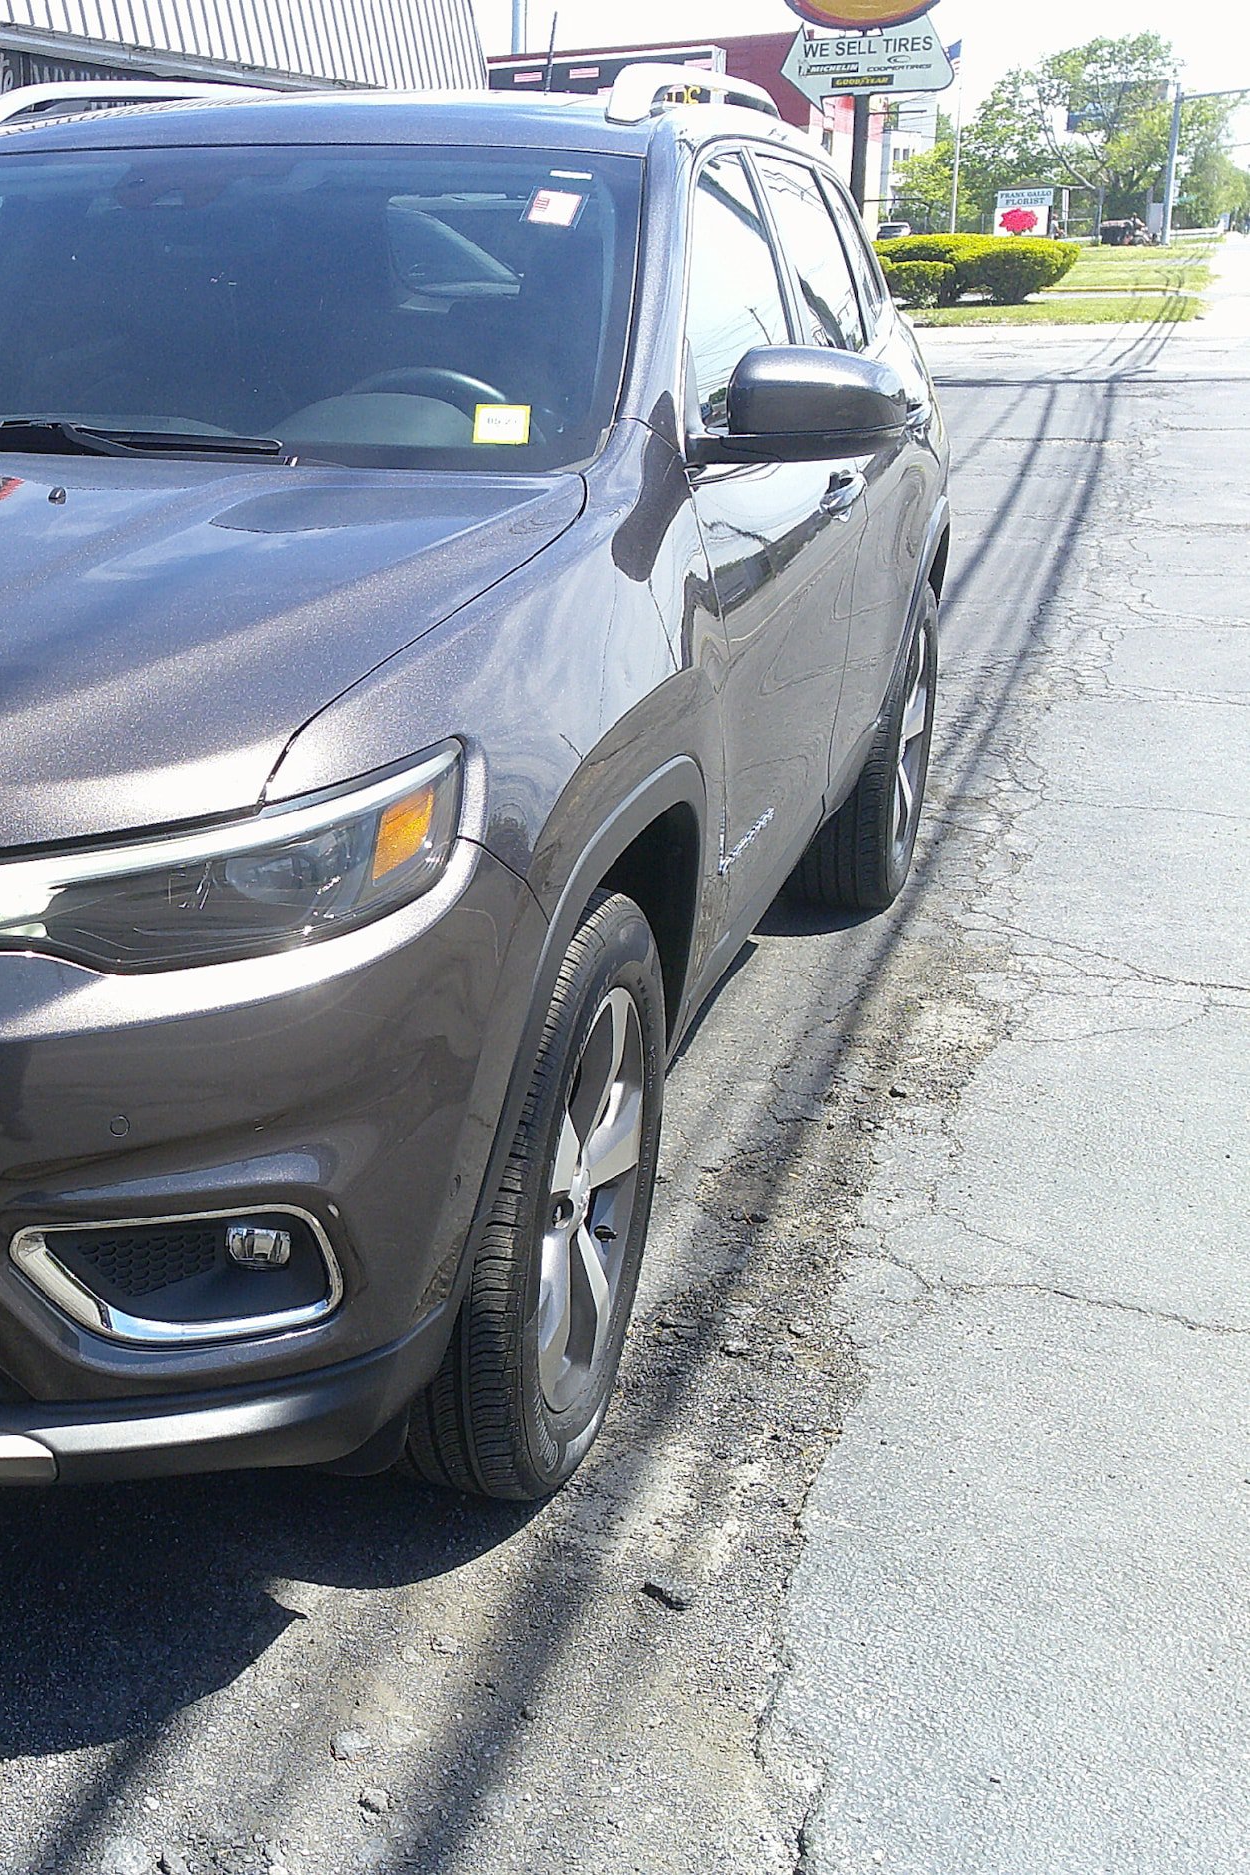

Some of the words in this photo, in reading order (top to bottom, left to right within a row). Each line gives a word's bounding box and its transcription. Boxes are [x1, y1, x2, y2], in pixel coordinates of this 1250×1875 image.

[803, 43, 830, 58] WE
[835, 40, 877, 56] SELL
[883, 36, 933, 53] TIRES
[810, 62, 859, 73] MICHELIN
[1027, 190, 1052, 198] GALLO
[1005, 198, 1045, 206] FLORIST
